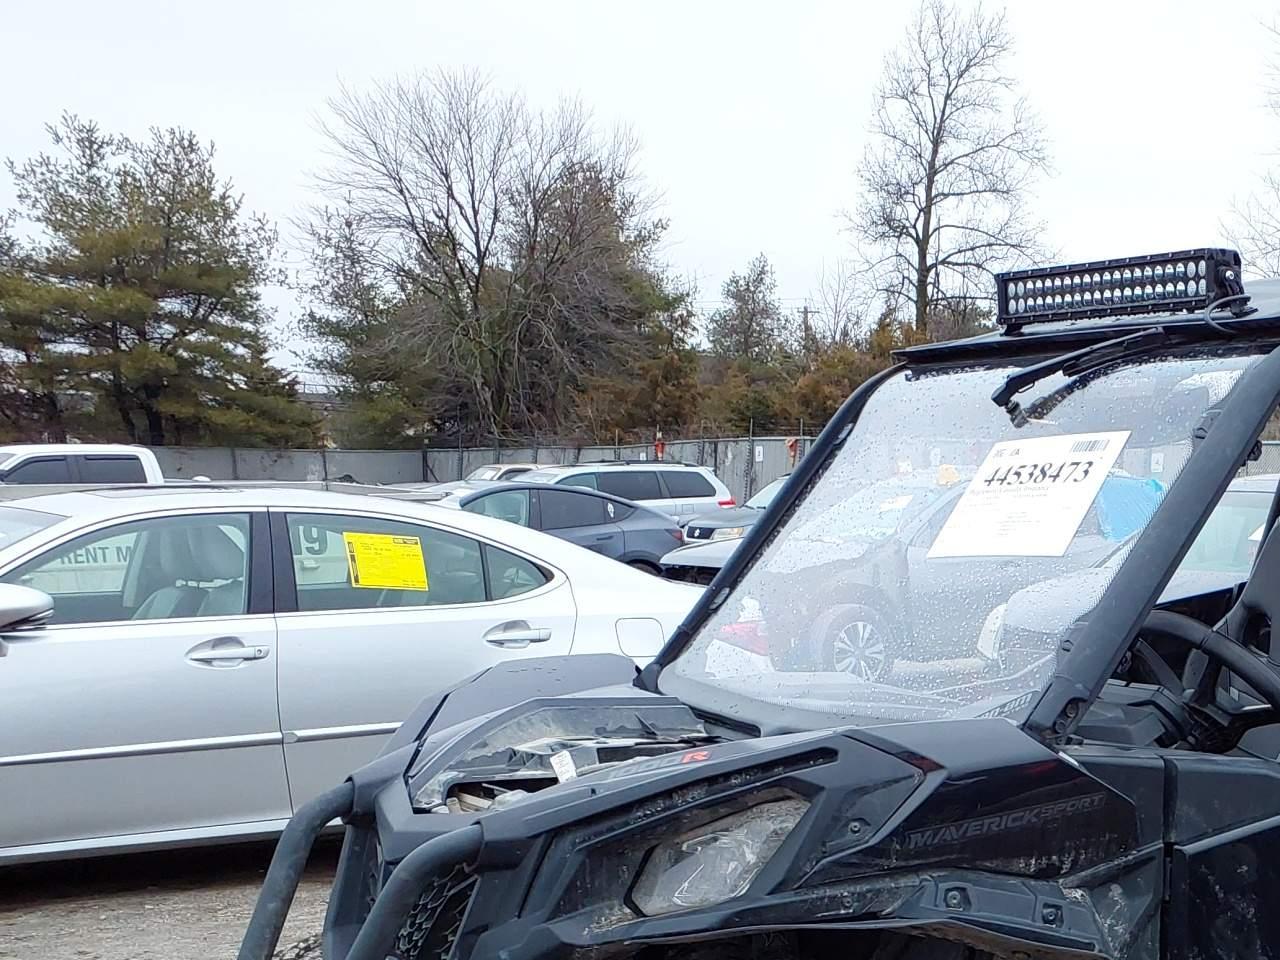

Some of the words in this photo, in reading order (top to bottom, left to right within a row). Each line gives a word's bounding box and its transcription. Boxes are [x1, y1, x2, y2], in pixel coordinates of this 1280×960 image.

[984, 460, 1094, 487] 44538473
[909, 808, 1040, 850] MAVERICK
[1040, 794, 1103, 818] SPORT
